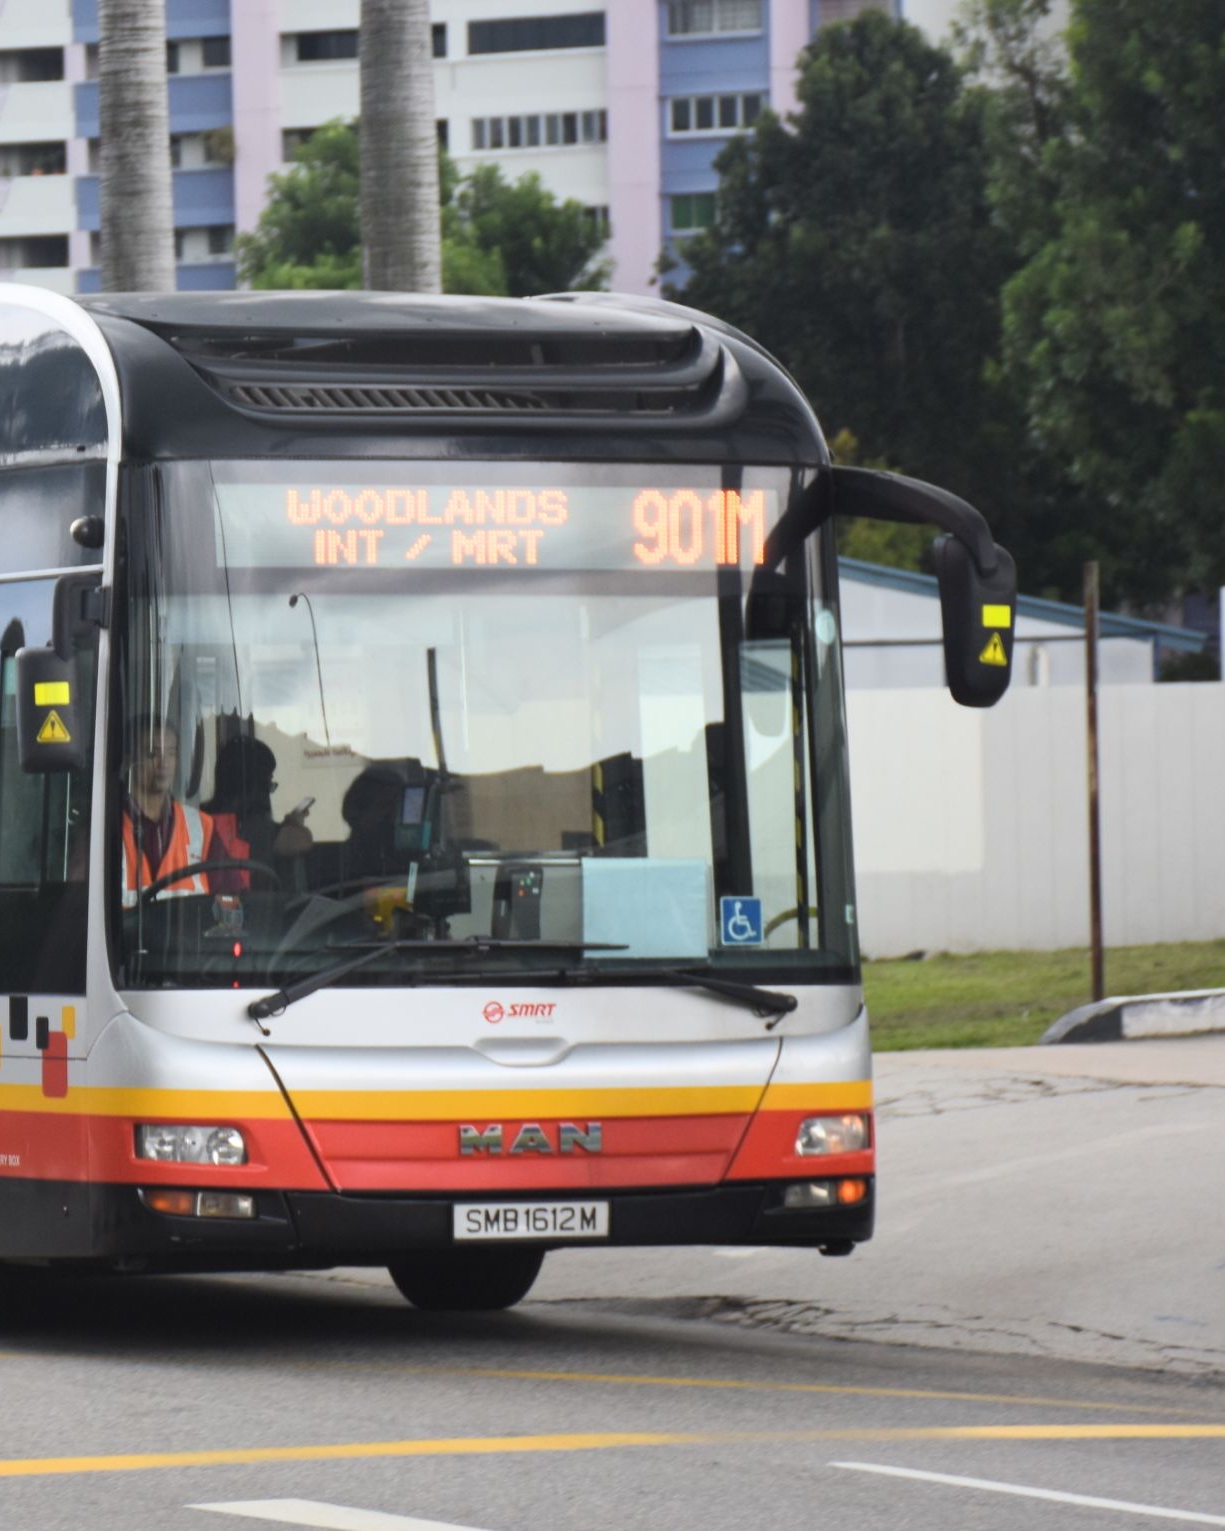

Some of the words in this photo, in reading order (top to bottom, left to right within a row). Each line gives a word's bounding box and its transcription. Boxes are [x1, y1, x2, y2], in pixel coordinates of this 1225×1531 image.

[287, 489, 568, 525] WOODLANDS
[633, 488, 765, 565] 901M
[314, 529, 385, 565] INT
[405, 533, 432, 560] /
[451, 529, 545, 565] MRT
[508, 1003, 557, 1017] SMRT
[459, 1122, 602, 1154] MAN
[8, 1154, 20, 1167] BOX
